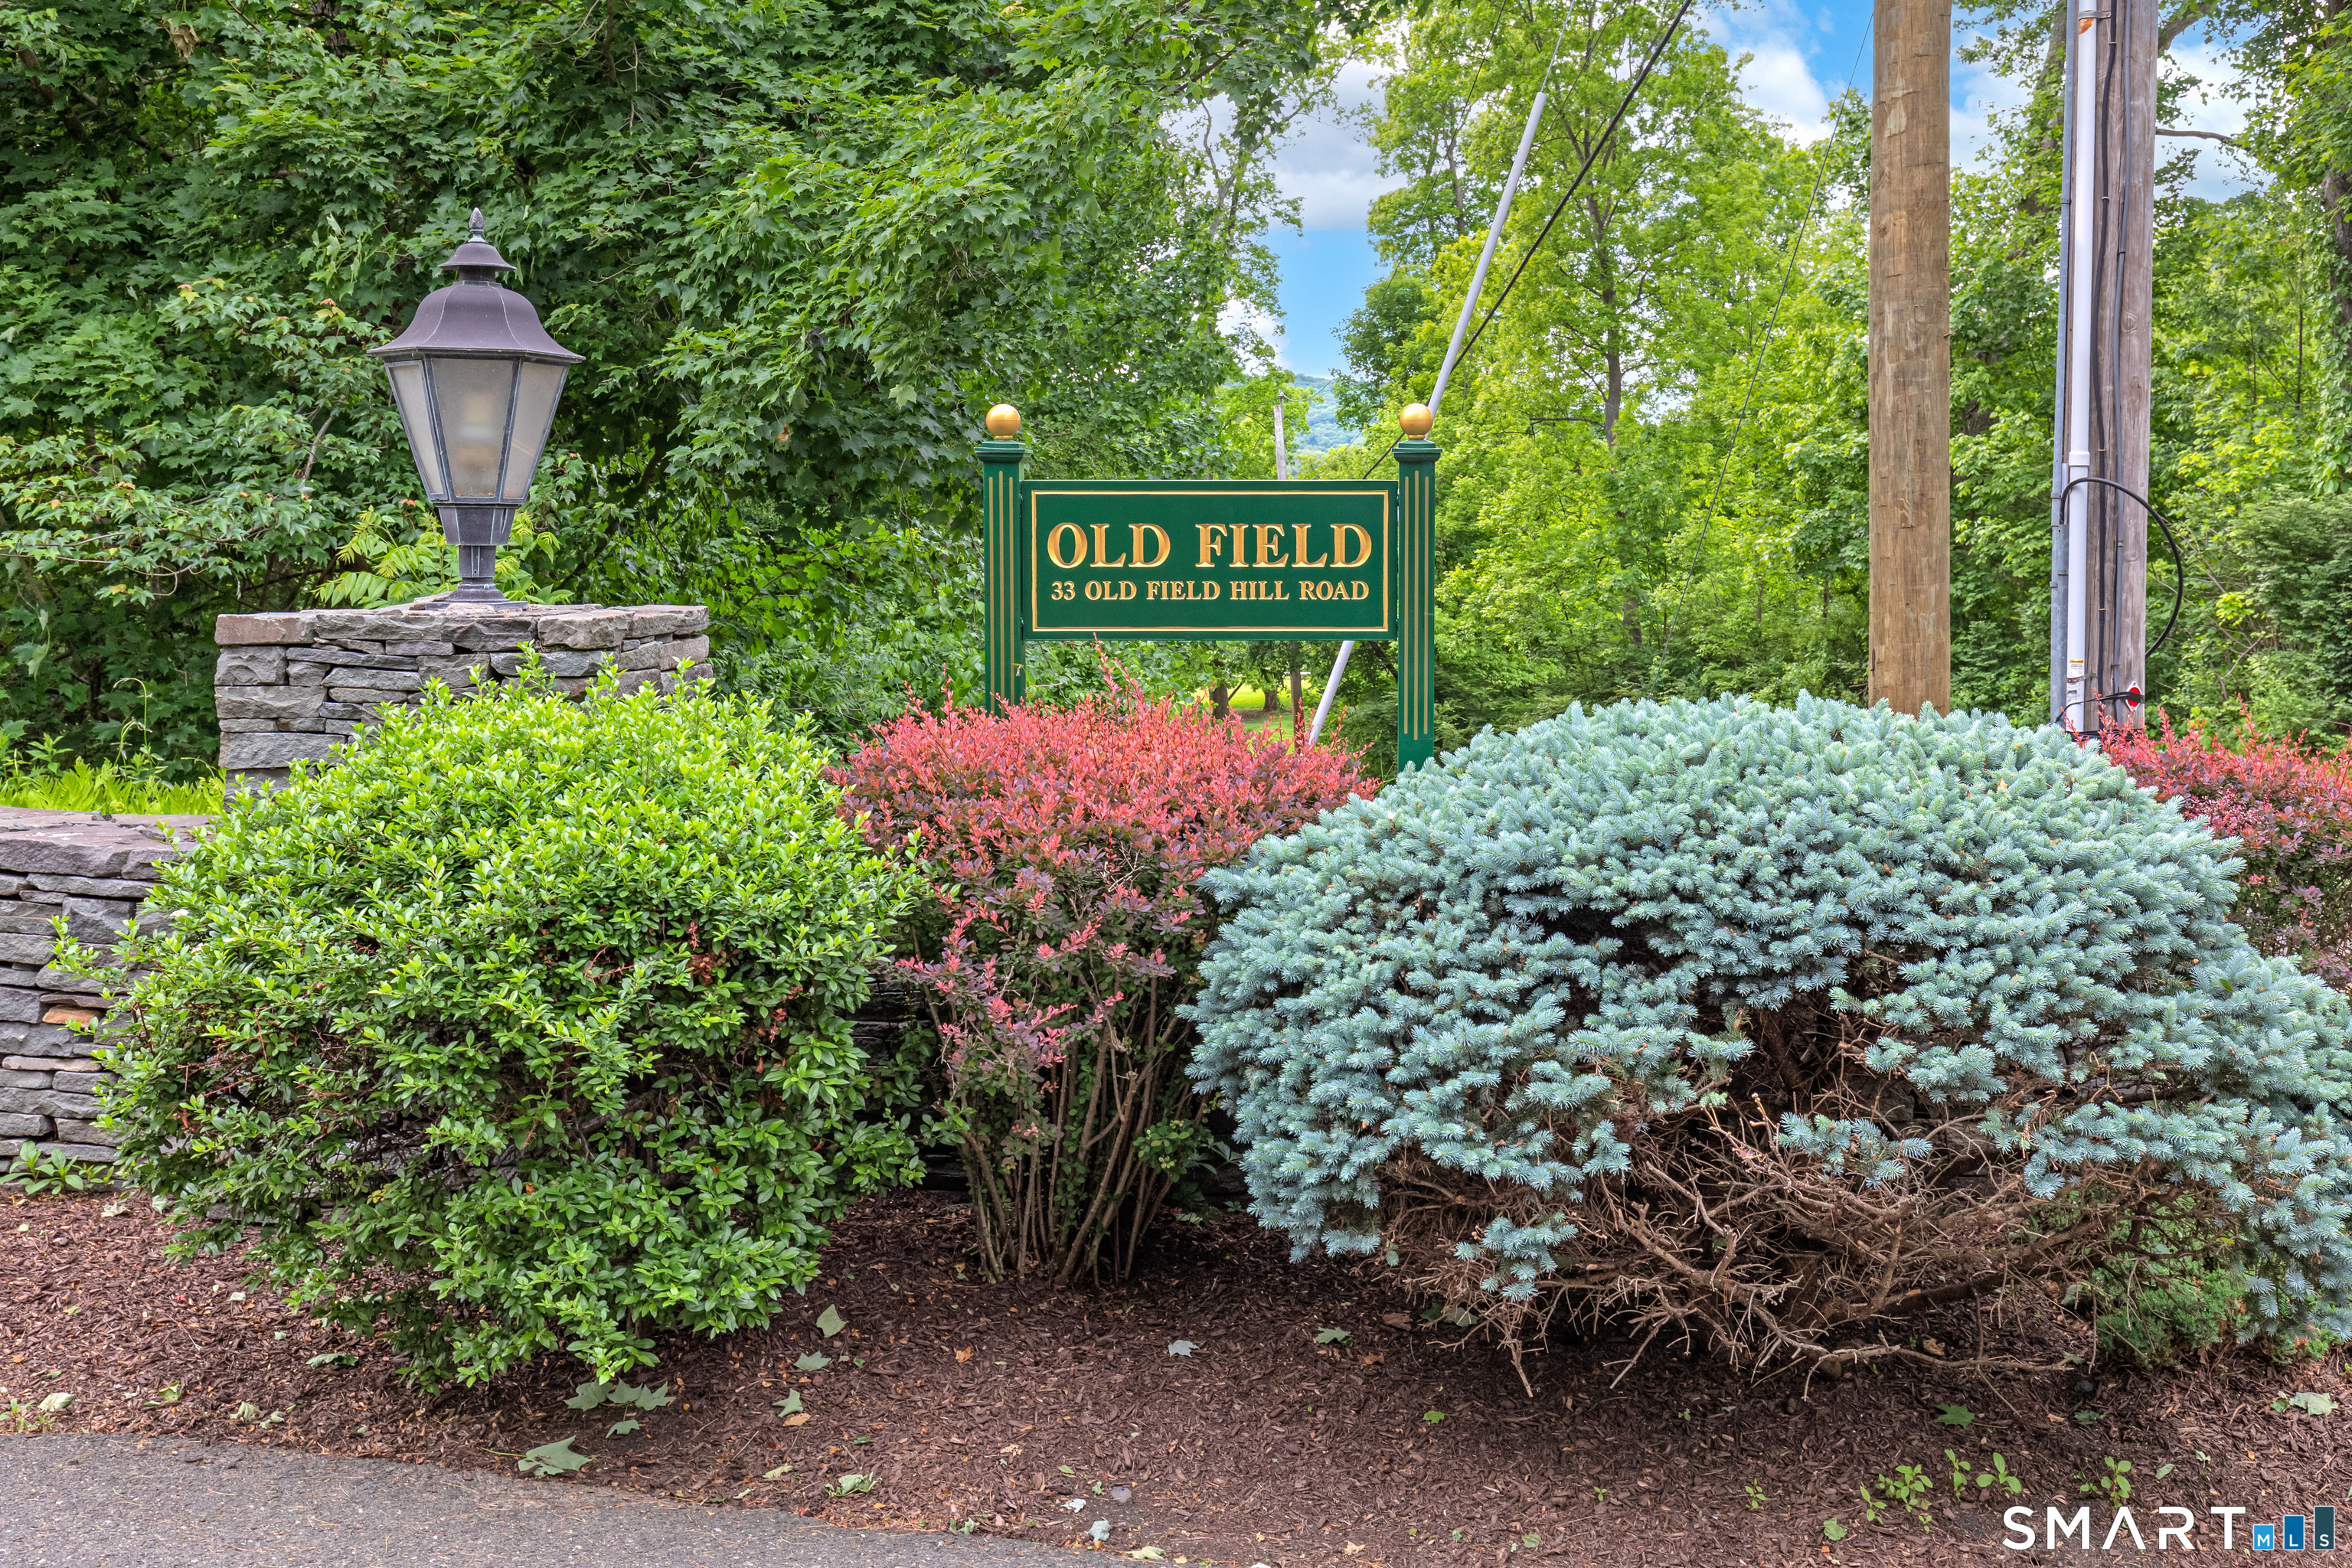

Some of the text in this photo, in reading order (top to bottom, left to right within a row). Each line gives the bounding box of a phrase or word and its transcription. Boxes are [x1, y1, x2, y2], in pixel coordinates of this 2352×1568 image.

[1047, 522, 1373, 569] OLD FIELD
[1050, 580, 1370, 601] 33 OLD FIELD HILL ROAD
